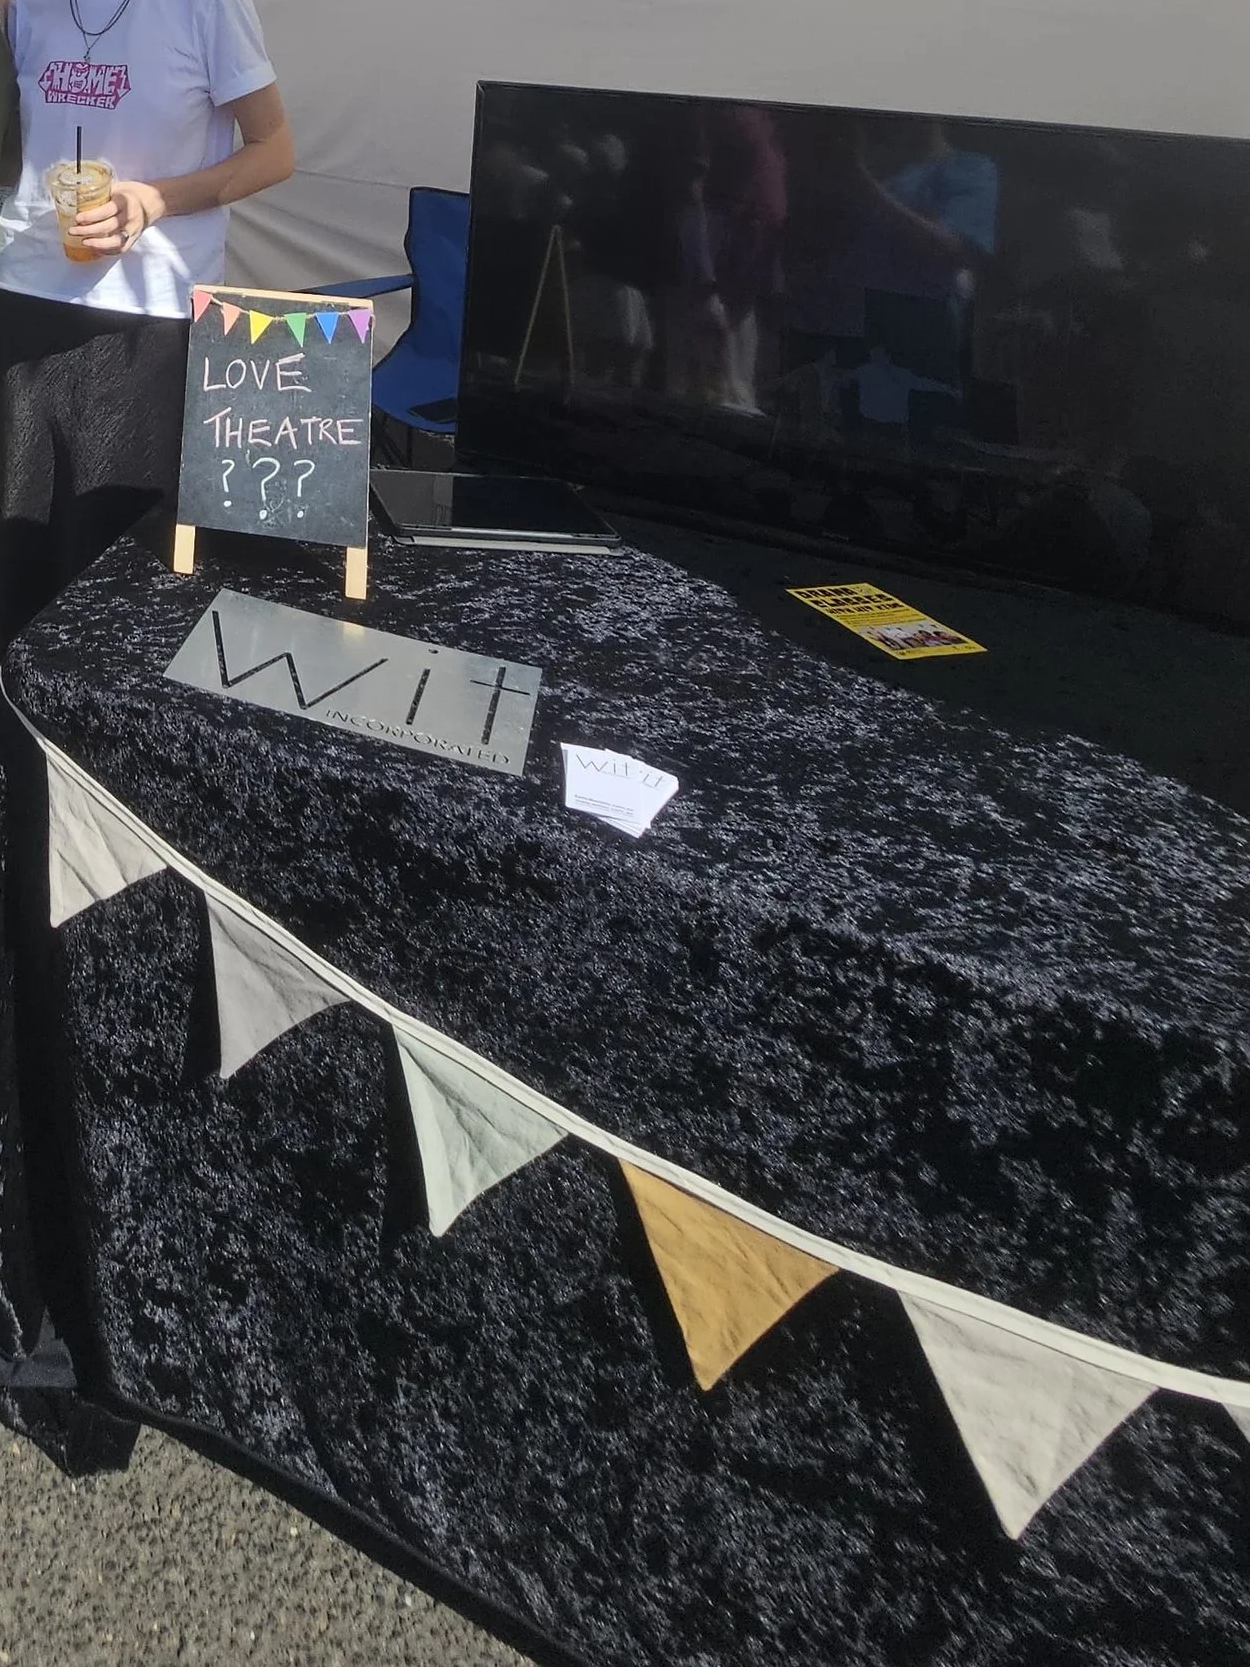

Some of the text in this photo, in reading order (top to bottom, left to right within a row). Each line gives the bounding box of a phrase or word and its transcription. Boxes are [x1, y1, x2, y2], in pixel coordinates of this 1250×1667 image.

[46, 90, 116, 109] WRECKER
[203, 352, 312, 393] LOVE
[203, 406, 364, 450] THEATRE
[325, 709, 511, 766] INCORPORATED
